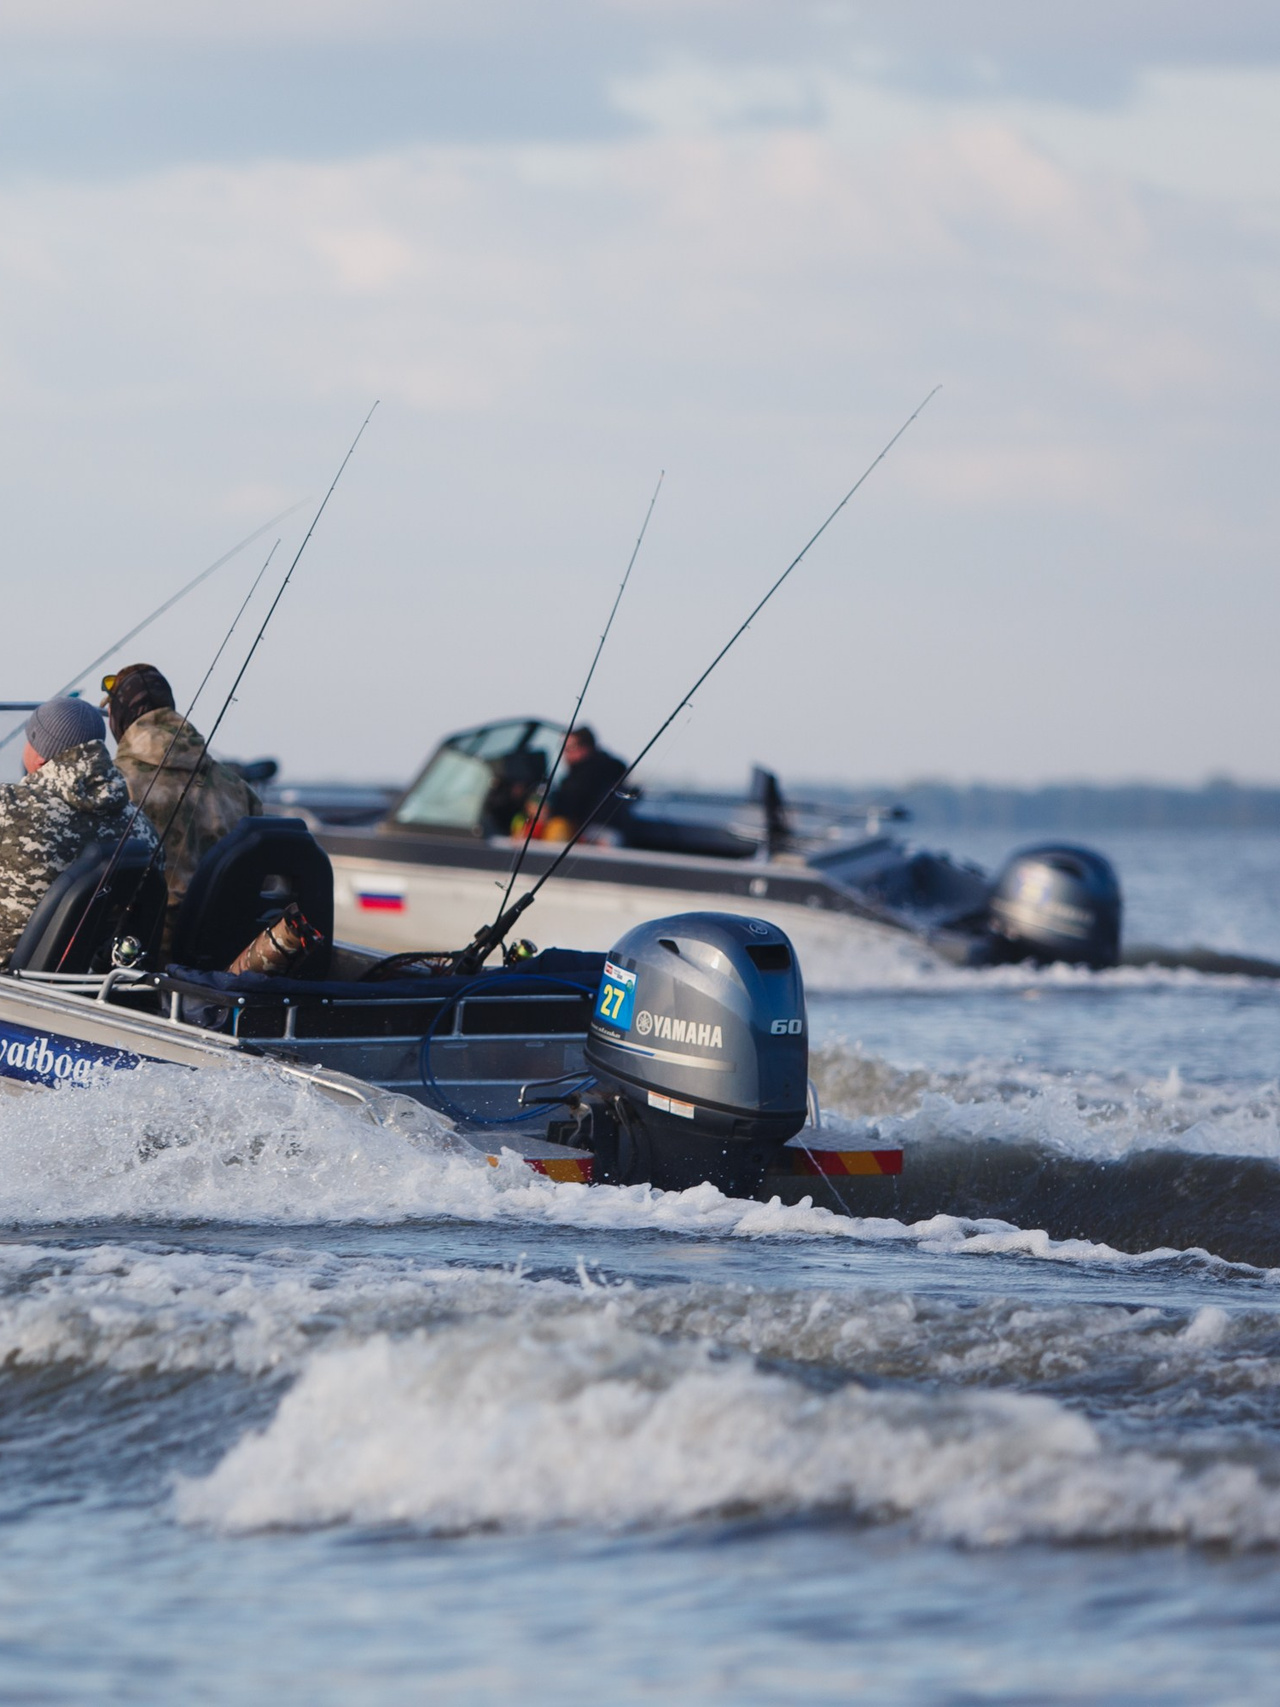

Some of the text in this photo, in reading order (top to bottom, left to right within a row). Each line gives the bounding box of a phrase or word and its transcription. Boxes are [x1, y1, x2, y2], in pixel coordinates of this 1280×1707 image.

[601, 983, 625, 1020] 27
[653, 1014, 723, 1048] YAMAHA
[770, 1018, 803, 1036] 60
